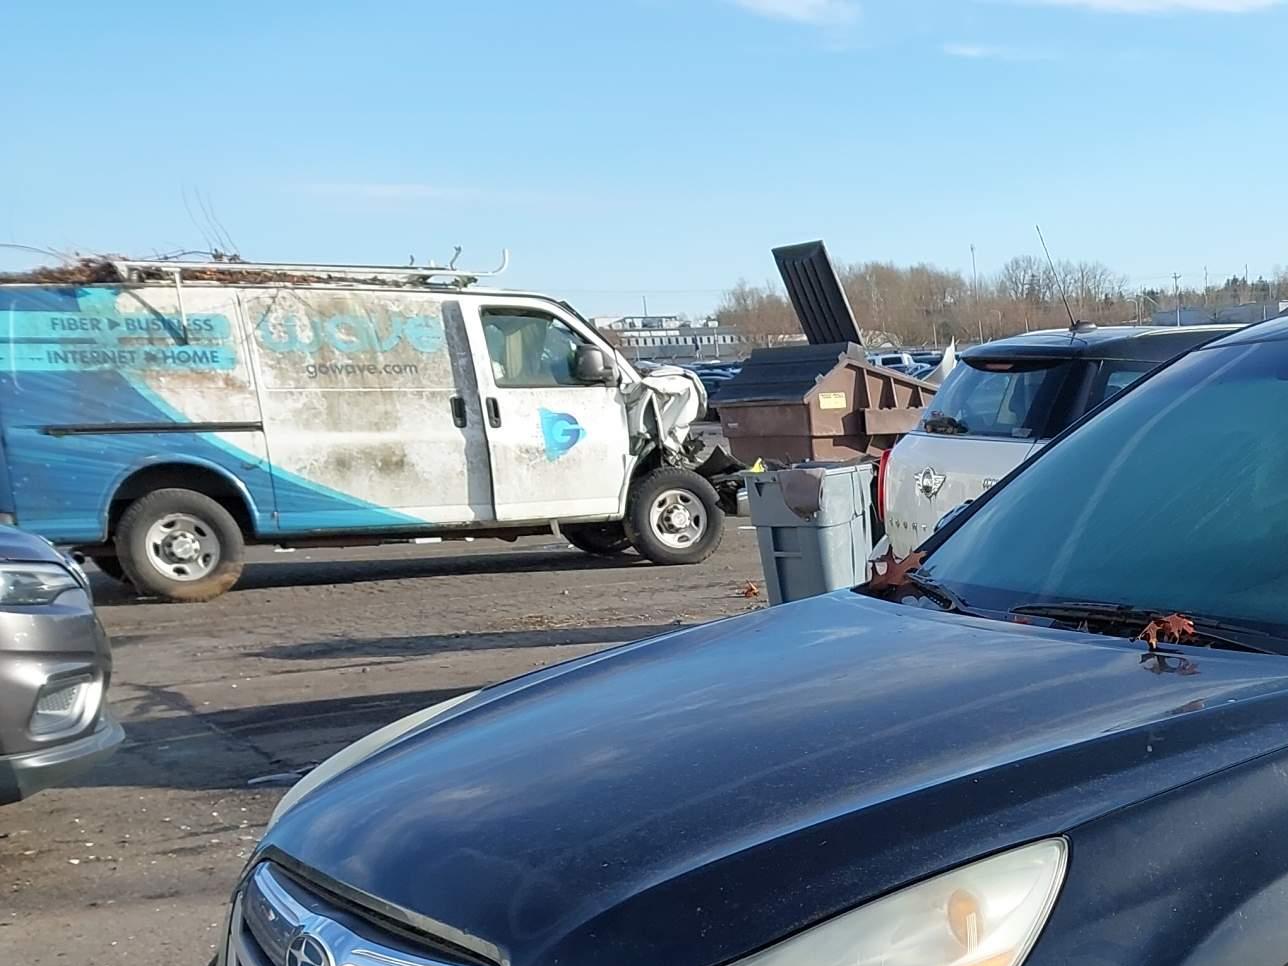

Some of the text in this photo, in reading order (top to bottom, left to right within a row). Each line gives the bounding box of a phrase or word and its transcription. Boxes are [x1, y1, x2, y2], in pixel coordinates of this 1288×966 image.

[50, 317, 214, 331] FIBER BUSNESS
[256, 312, 446, 353] wave
[47, 350, 220, 364] INTERNET HOME
[306, 362, 418, 379] gowave.com
